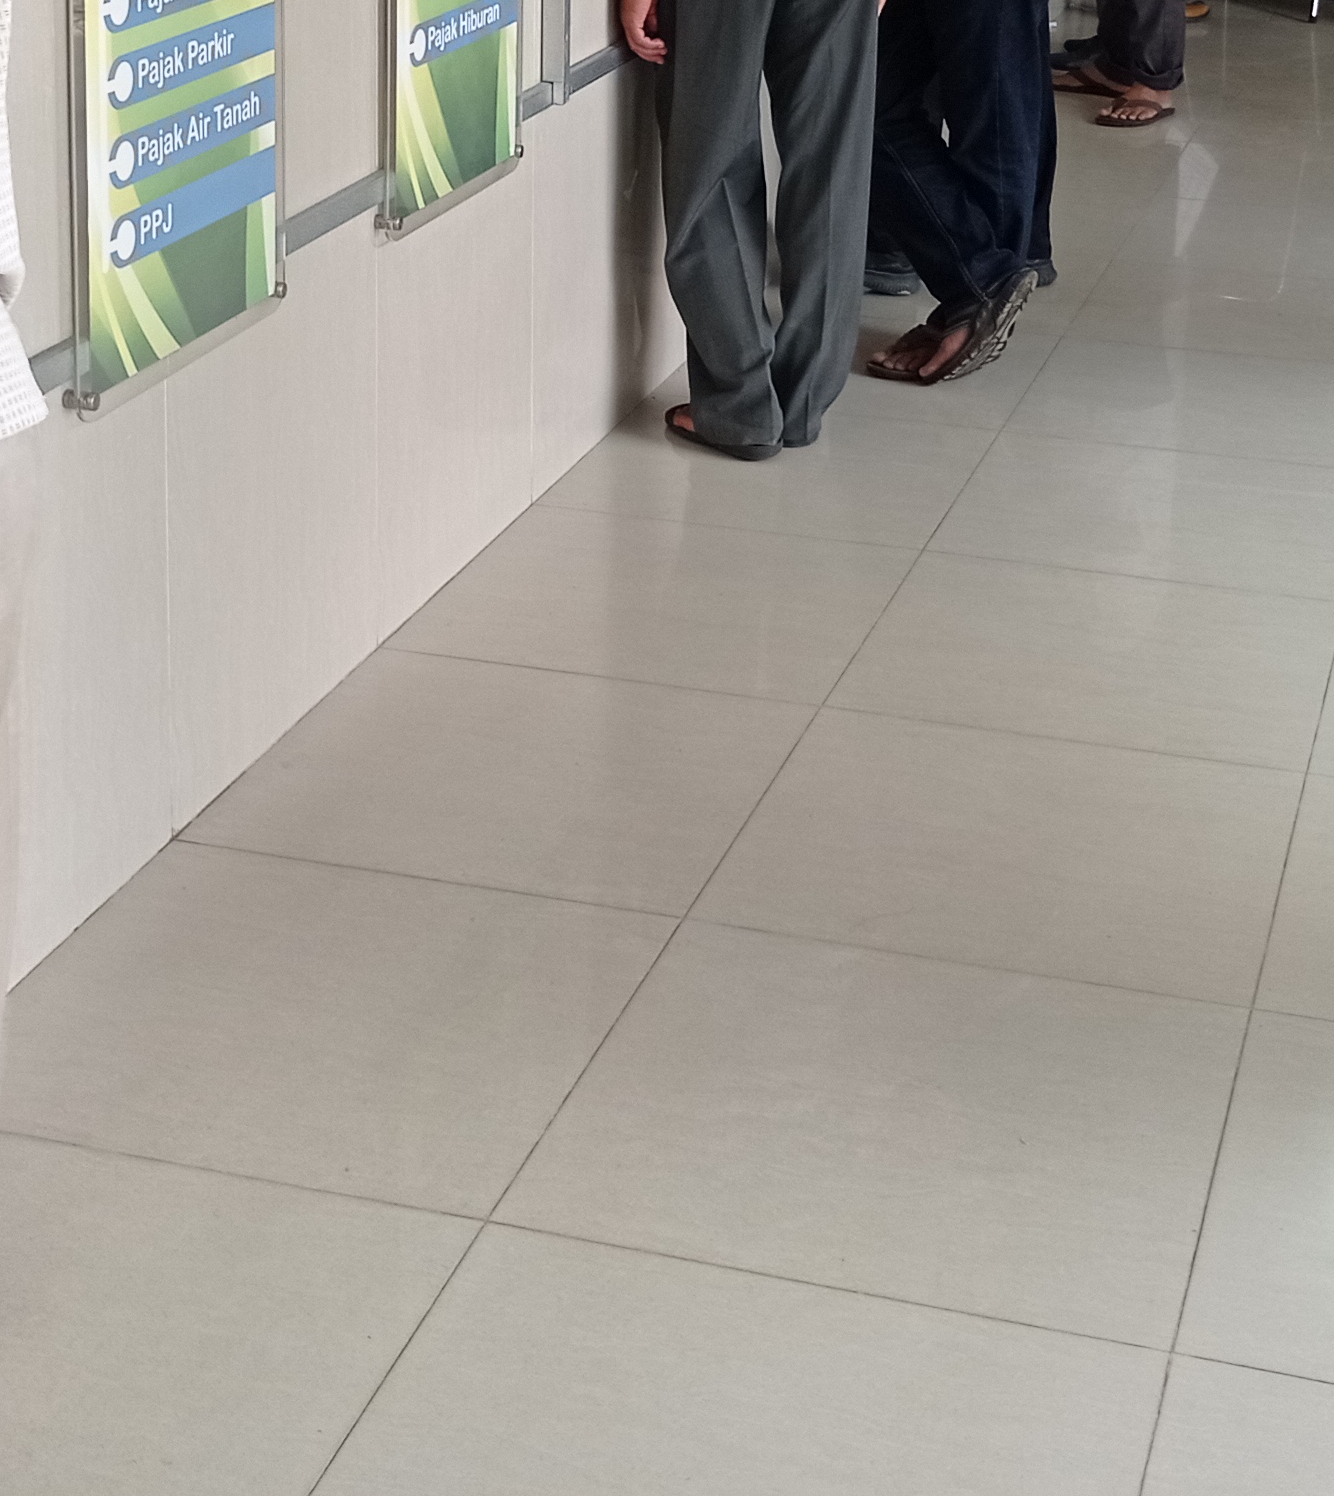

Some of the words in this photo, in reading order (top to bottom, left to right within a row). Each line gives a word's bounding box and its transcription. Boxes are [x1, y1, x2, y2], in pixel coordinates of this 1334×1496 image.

[427, 19, 458, 51] Pajak
[459, 2, 500, 37] Hiburan
[137, 47, 184, 89] Pajak
[187, 29, 236, 70] Parkir
[137, 123, 183, 167] Pajak
[186, 114, 211, 146] Air
[214, 91, 261, 134] Tanah
[140, 203, 173, 245] PPJ
